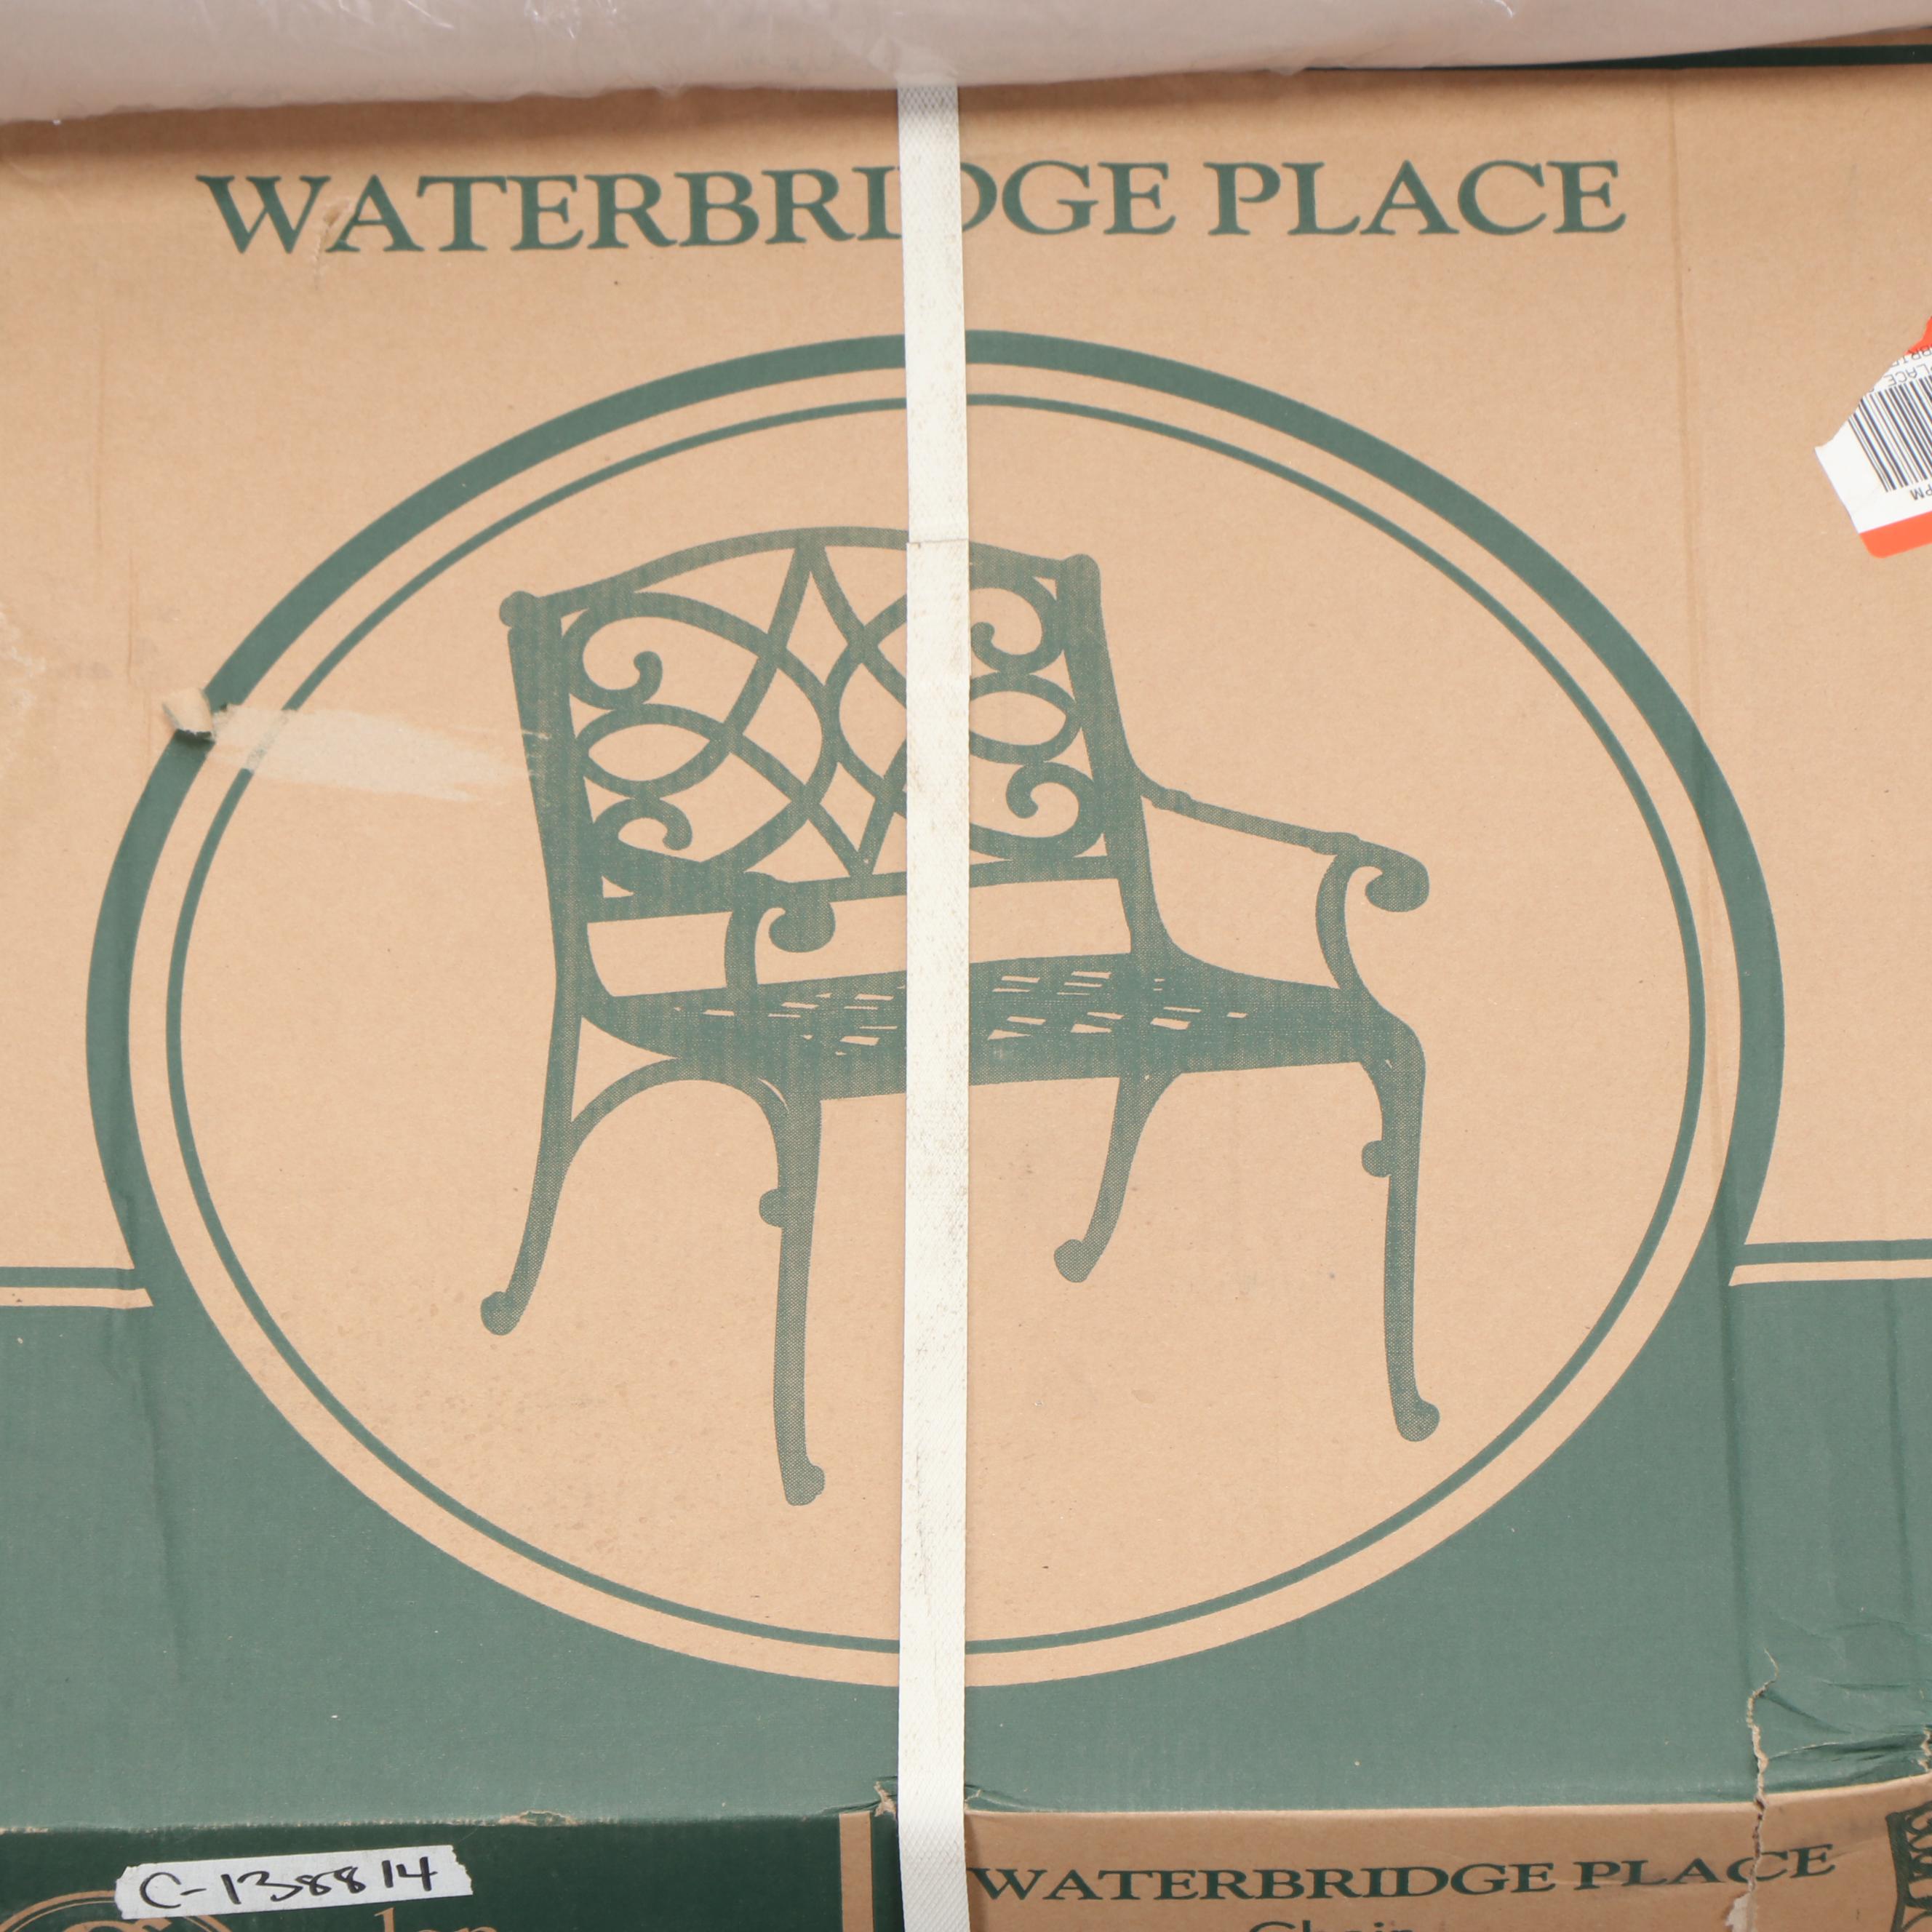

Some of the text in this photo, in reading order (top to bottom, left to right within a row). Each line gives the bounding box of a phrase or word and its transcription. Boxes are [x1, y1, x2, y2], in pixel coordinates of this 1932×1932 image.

[1202, 159, 1627, 236] PLACE
[1883, 363, 1932, 387] LACE
[966, 1843, 1836, 1901] WATERBRIDGE PLACE
